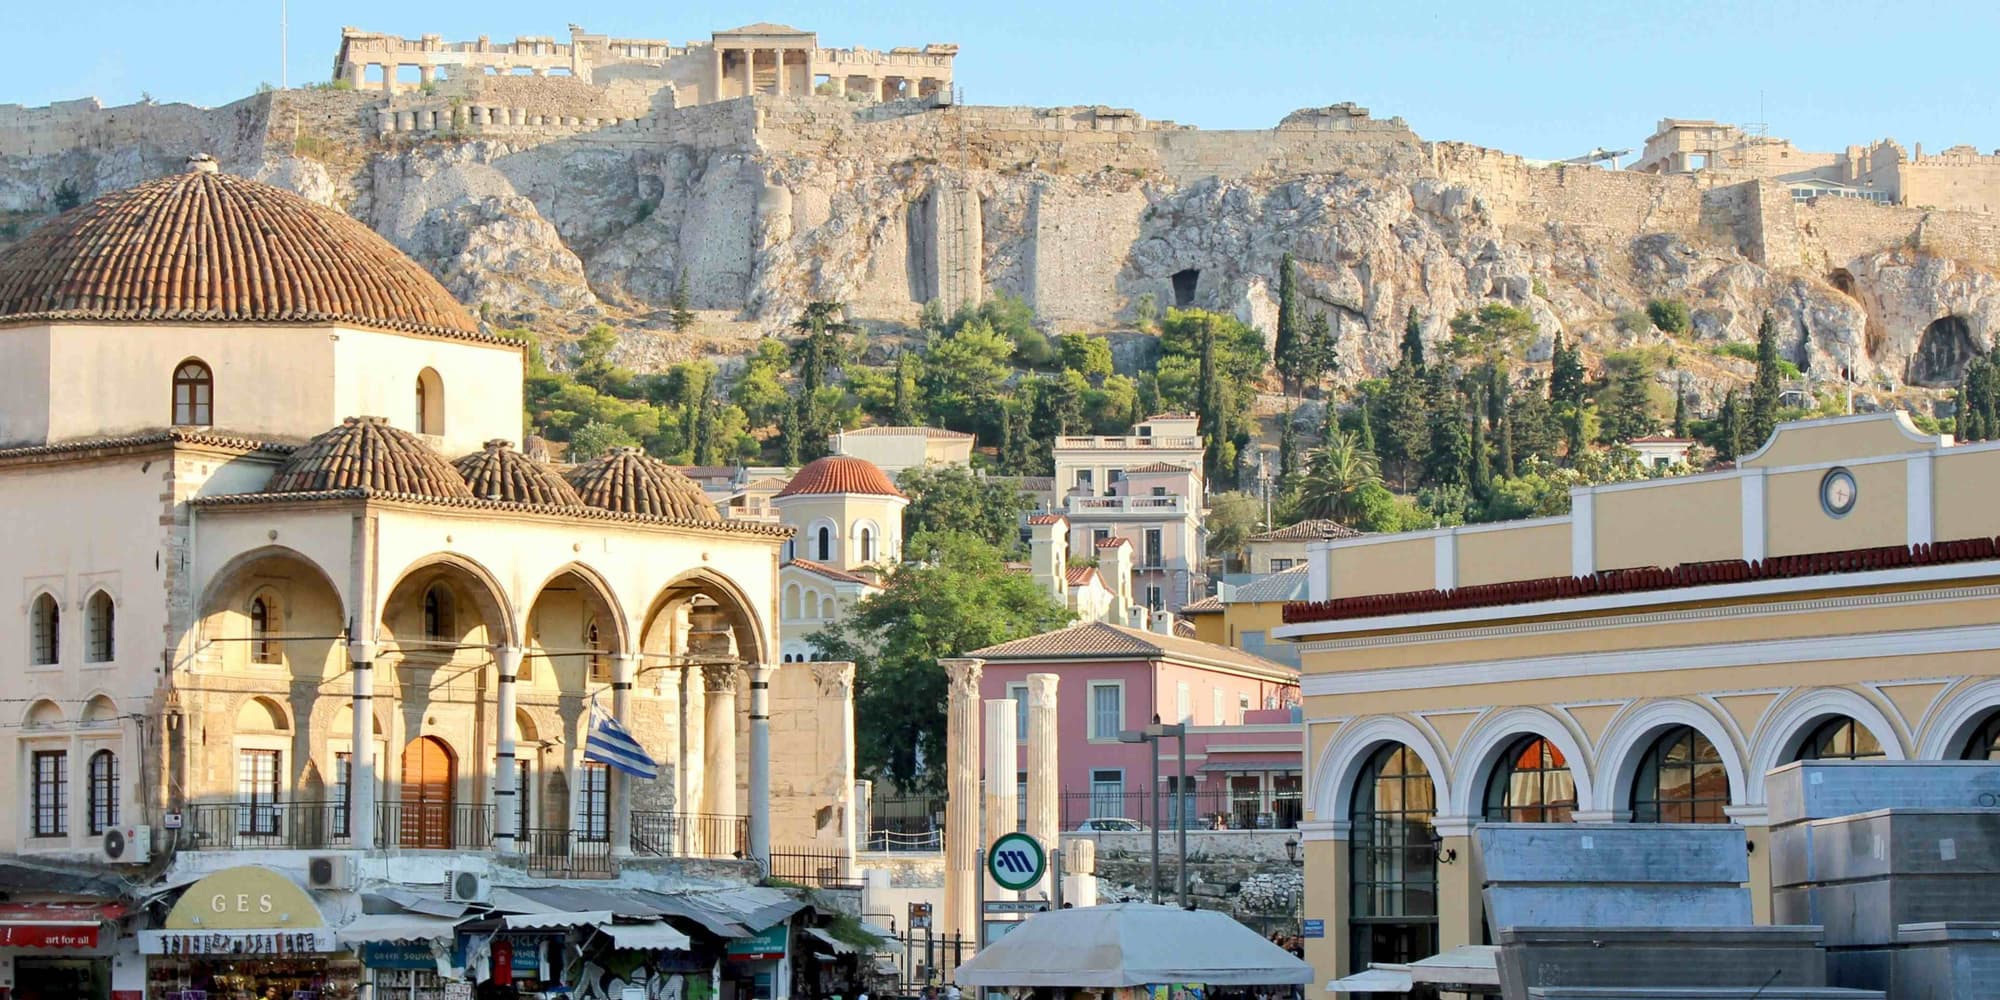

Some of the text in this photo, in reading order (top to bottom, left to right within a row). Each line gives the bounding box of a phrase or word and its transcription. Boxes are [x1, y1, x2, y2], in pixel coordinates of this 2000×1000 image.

[211, 894, 273, 913] GES
[45, 935, 89, 945] art for all
